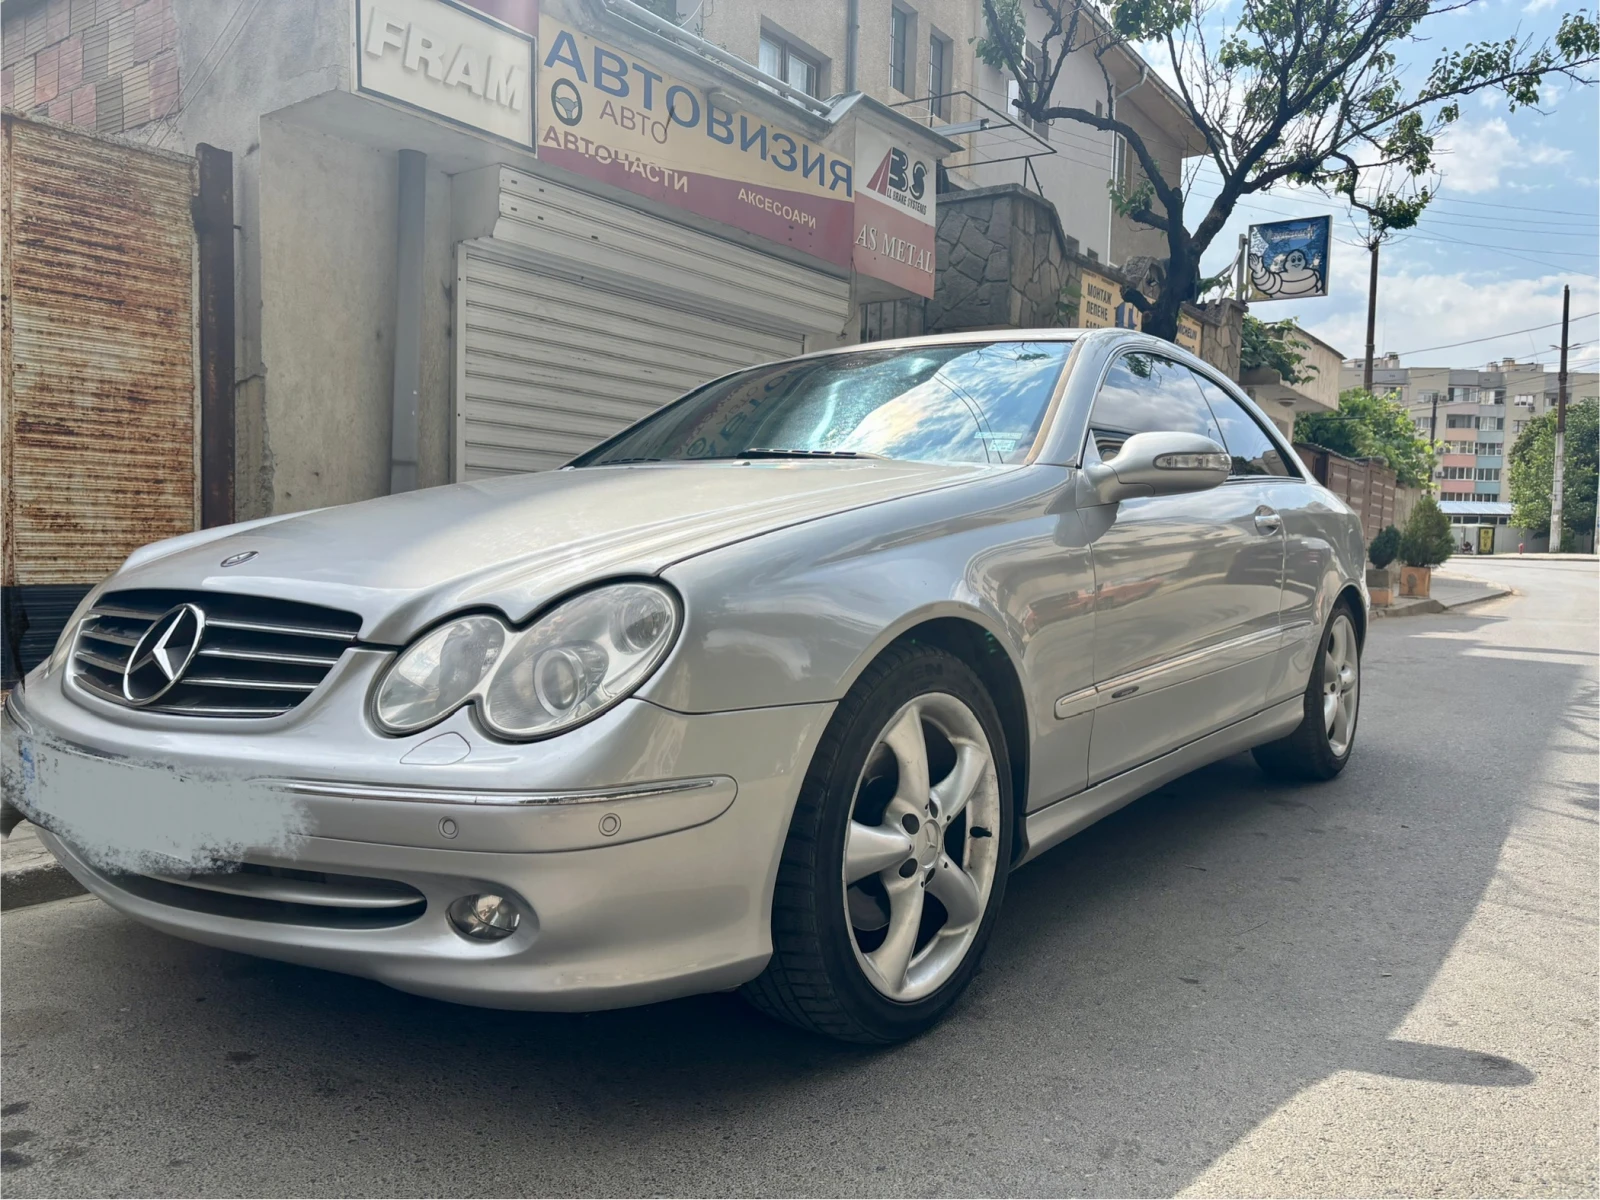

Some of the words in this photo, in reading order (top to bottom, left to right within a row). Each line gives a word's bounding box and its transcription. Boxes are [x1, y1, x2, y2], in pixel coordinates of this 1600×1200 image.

[365, 6, 527, 114] FRAM
[543, 29, 853, 199] АВТОВИЗИЯ
[599, 99, 668, 145] АВТО
[542, 125, 689, 194] АВТОЧАСТИ
[737, 188, 817, 230] АКСЕСОАРИ
[893, 190, 907, 206] BRAKE
[907, 198, 928, 216] SYSTEMS
[855, 223, 878, 252] AS
[881, 233, 934, 275] METAL
[1086, 300, 1108, 321] ЛЕПЕНЕ
[1087, 282, 1112, 306] МОНТАЖ
